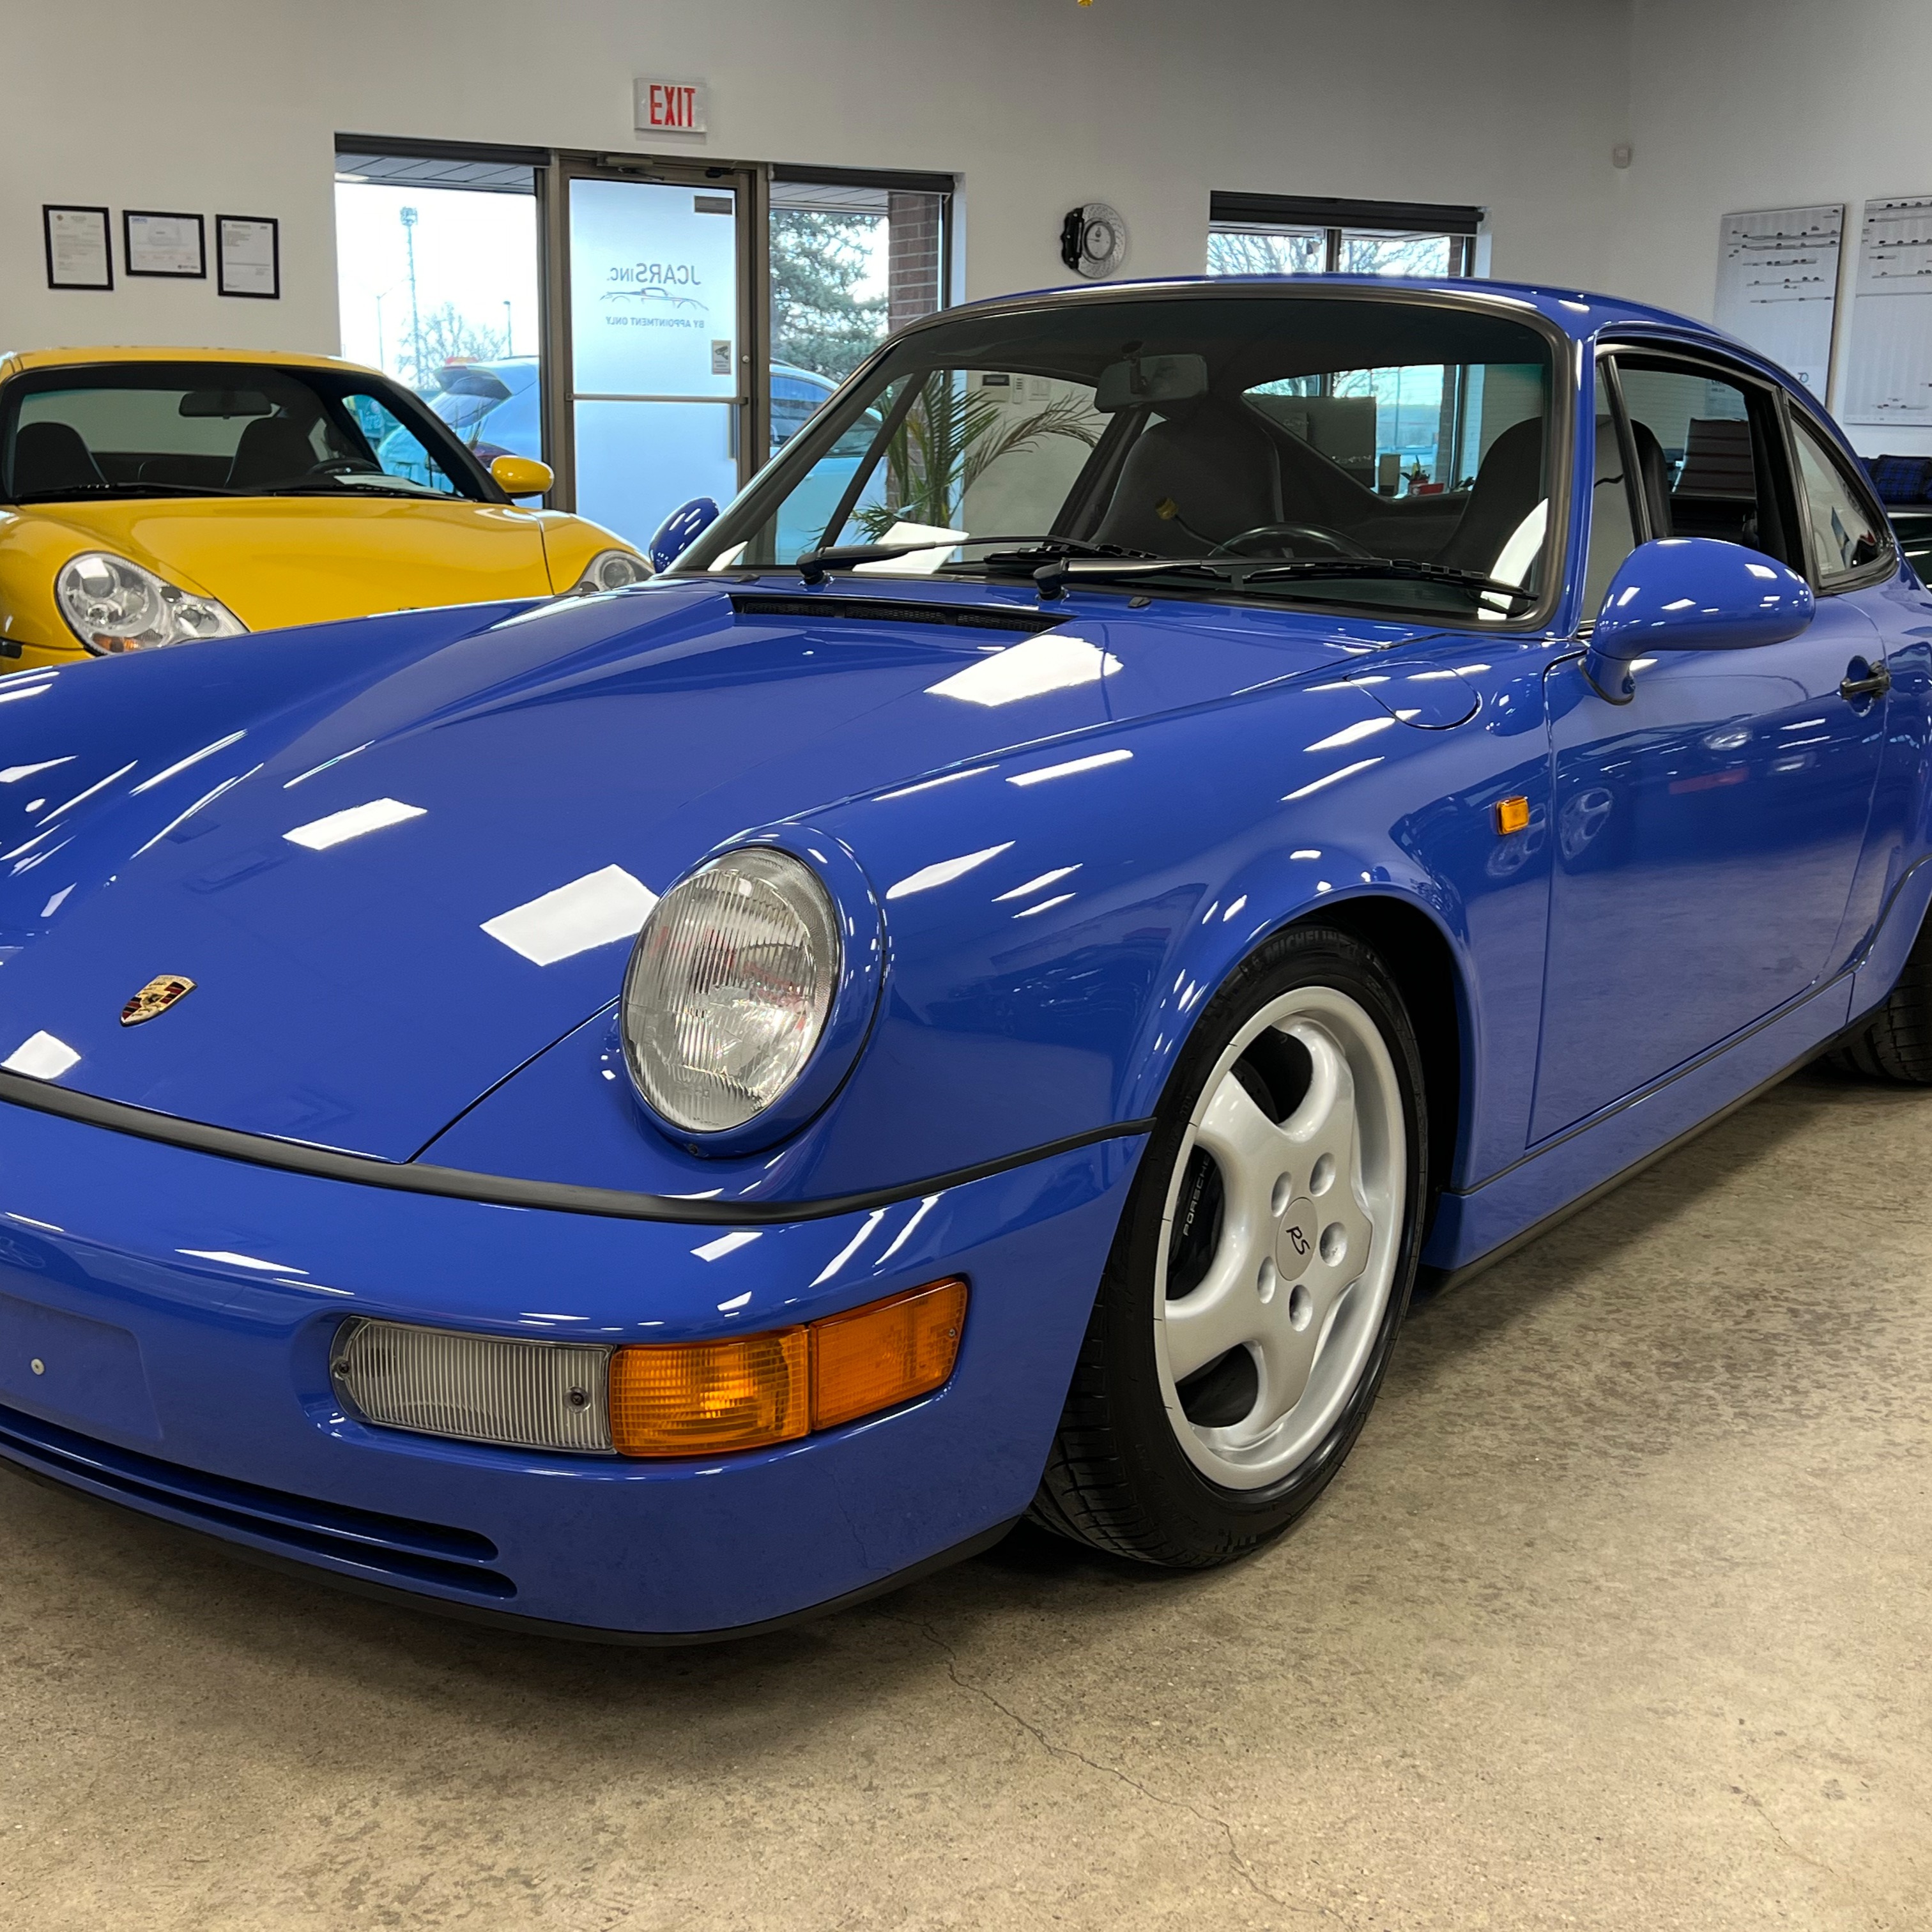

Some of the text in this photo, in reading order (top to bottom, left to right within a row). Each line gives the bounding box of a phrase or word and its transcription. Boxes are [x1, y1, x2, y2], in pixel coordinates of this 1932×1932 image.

[650, 84, 695, 127] EXIT
[1264, 930, 1338, 963] MICHELIN
[1183, 1153, 1210, 1236] PORSCHE
[1286, 1225, 1310, 1255] RS
